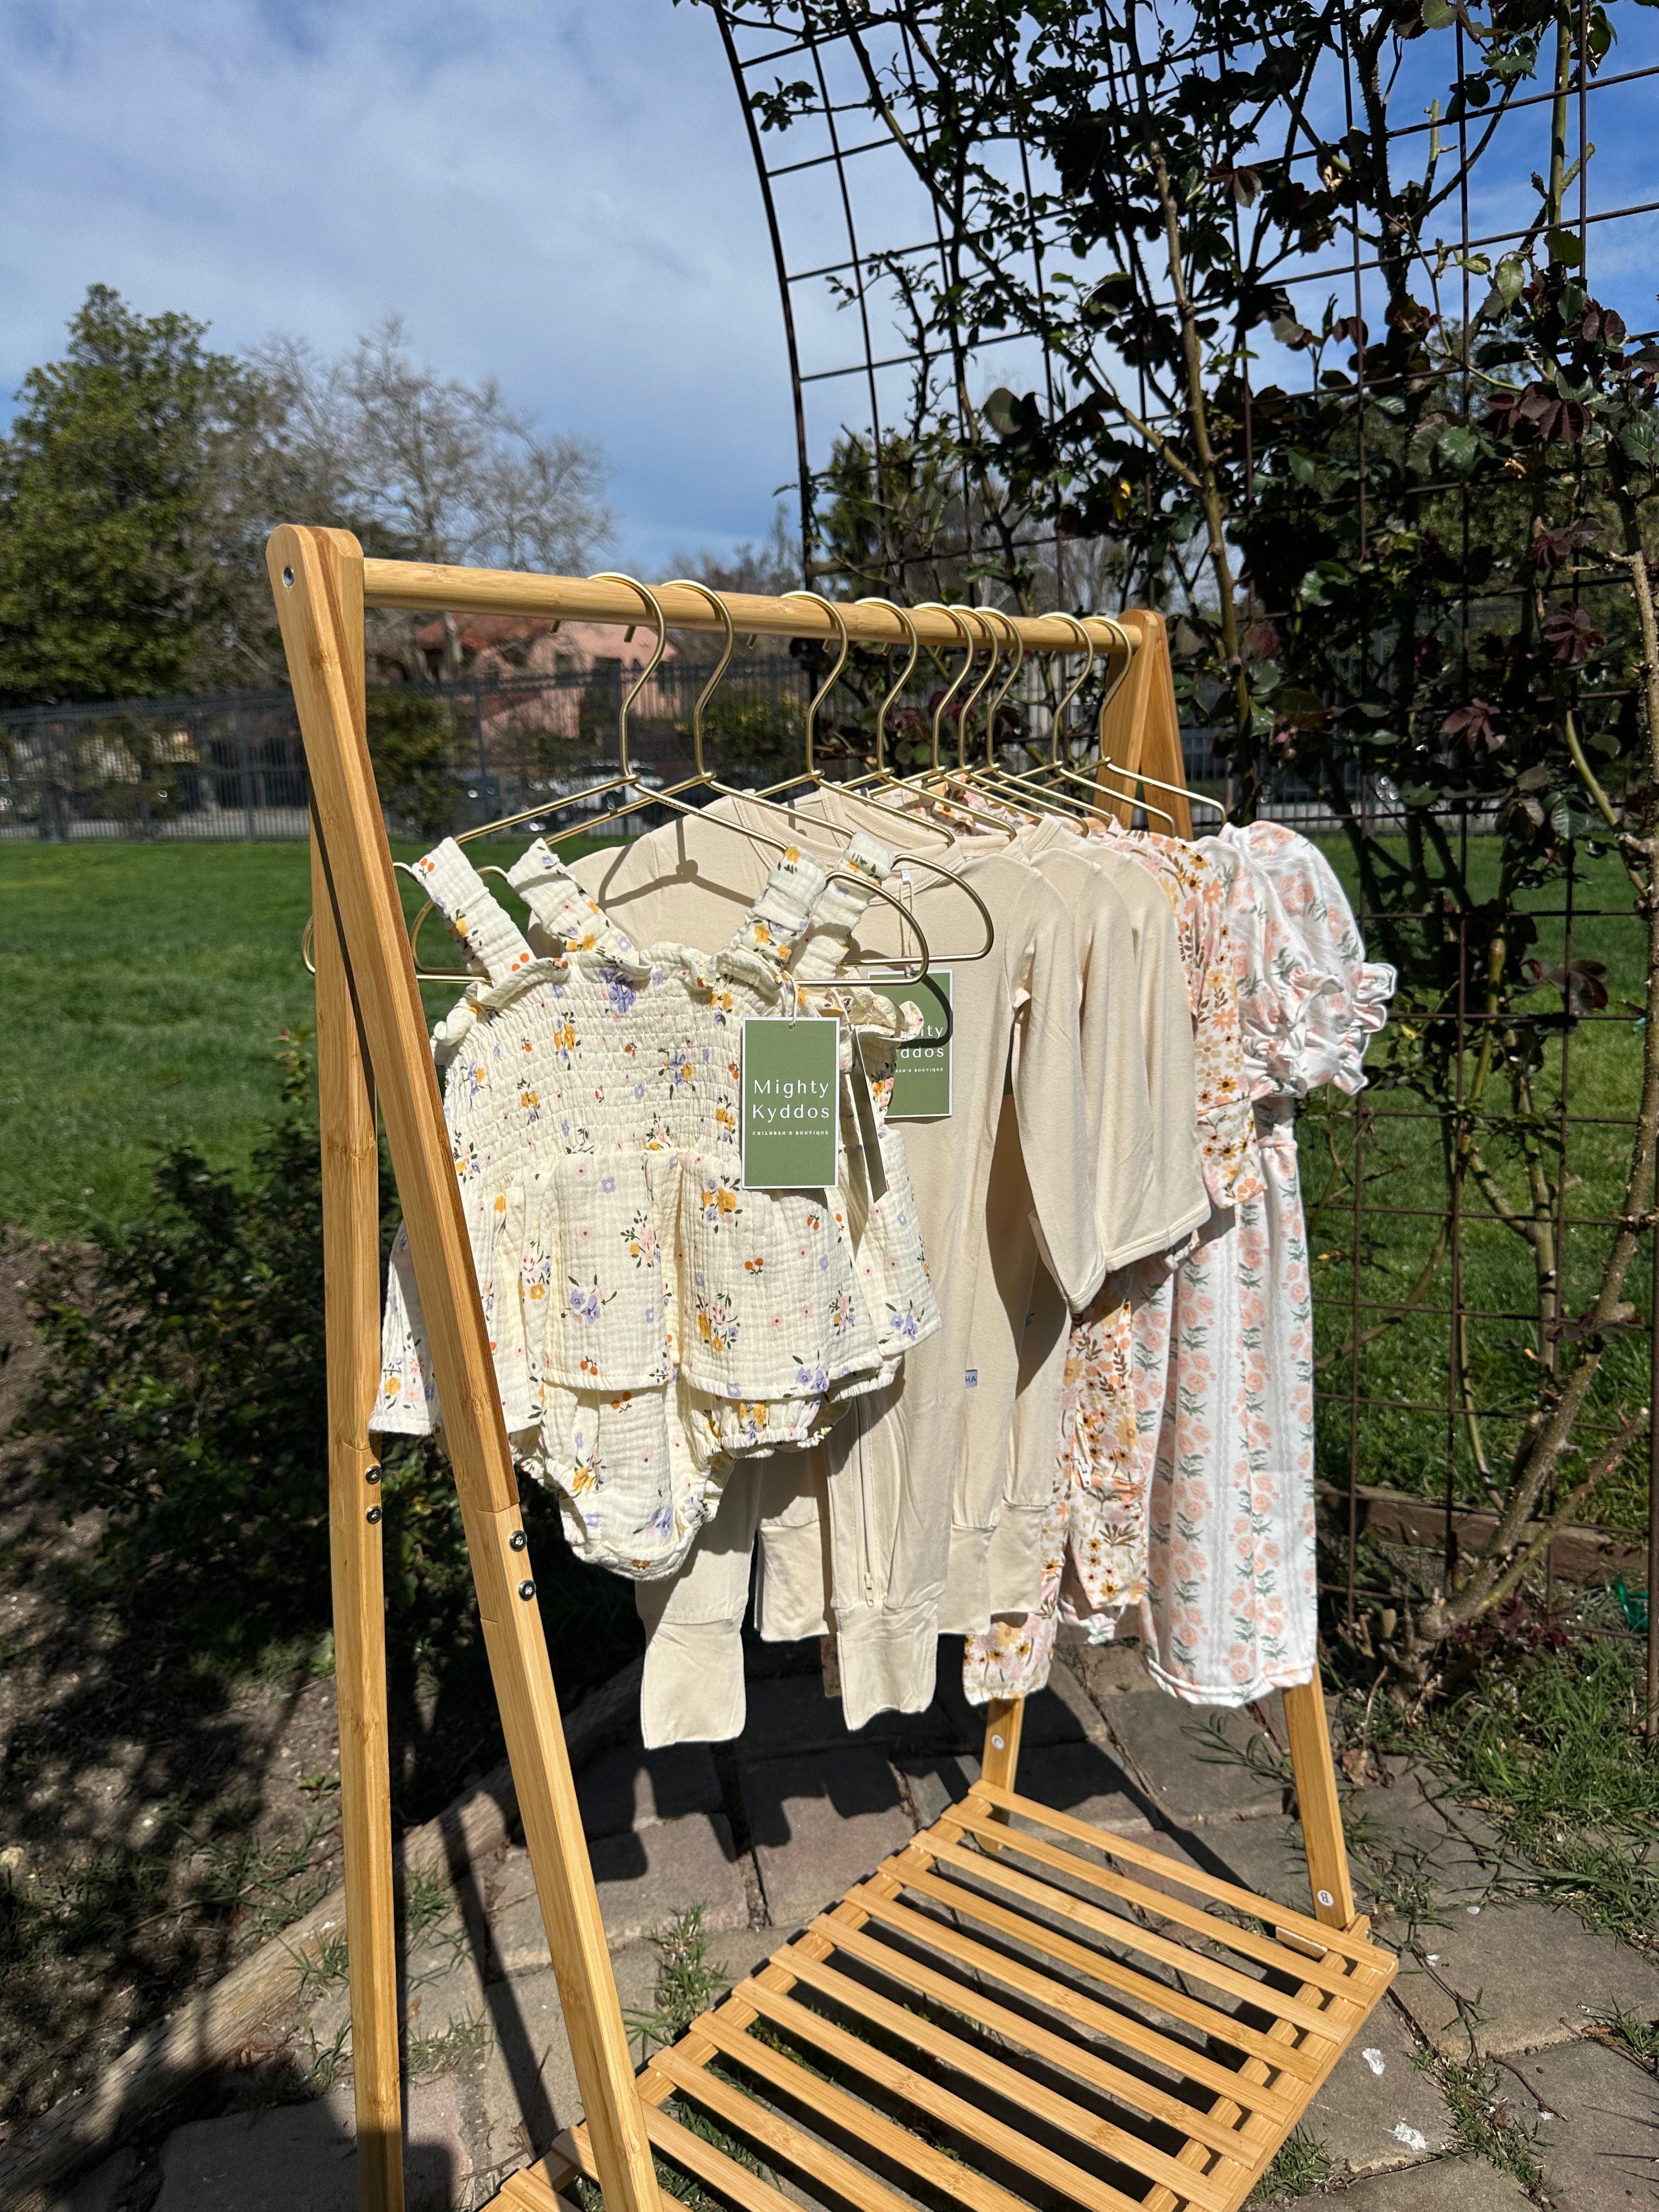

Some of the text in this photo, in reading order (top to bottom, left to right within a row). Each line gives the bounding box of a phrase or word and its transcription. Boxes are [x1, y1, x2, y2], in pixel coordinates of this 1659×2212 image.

[896, 1046, 944, 1059] ddos
[754, 1079, 829, 1098] Mighty
[753, 1104, 830, 1123] Kyddos
